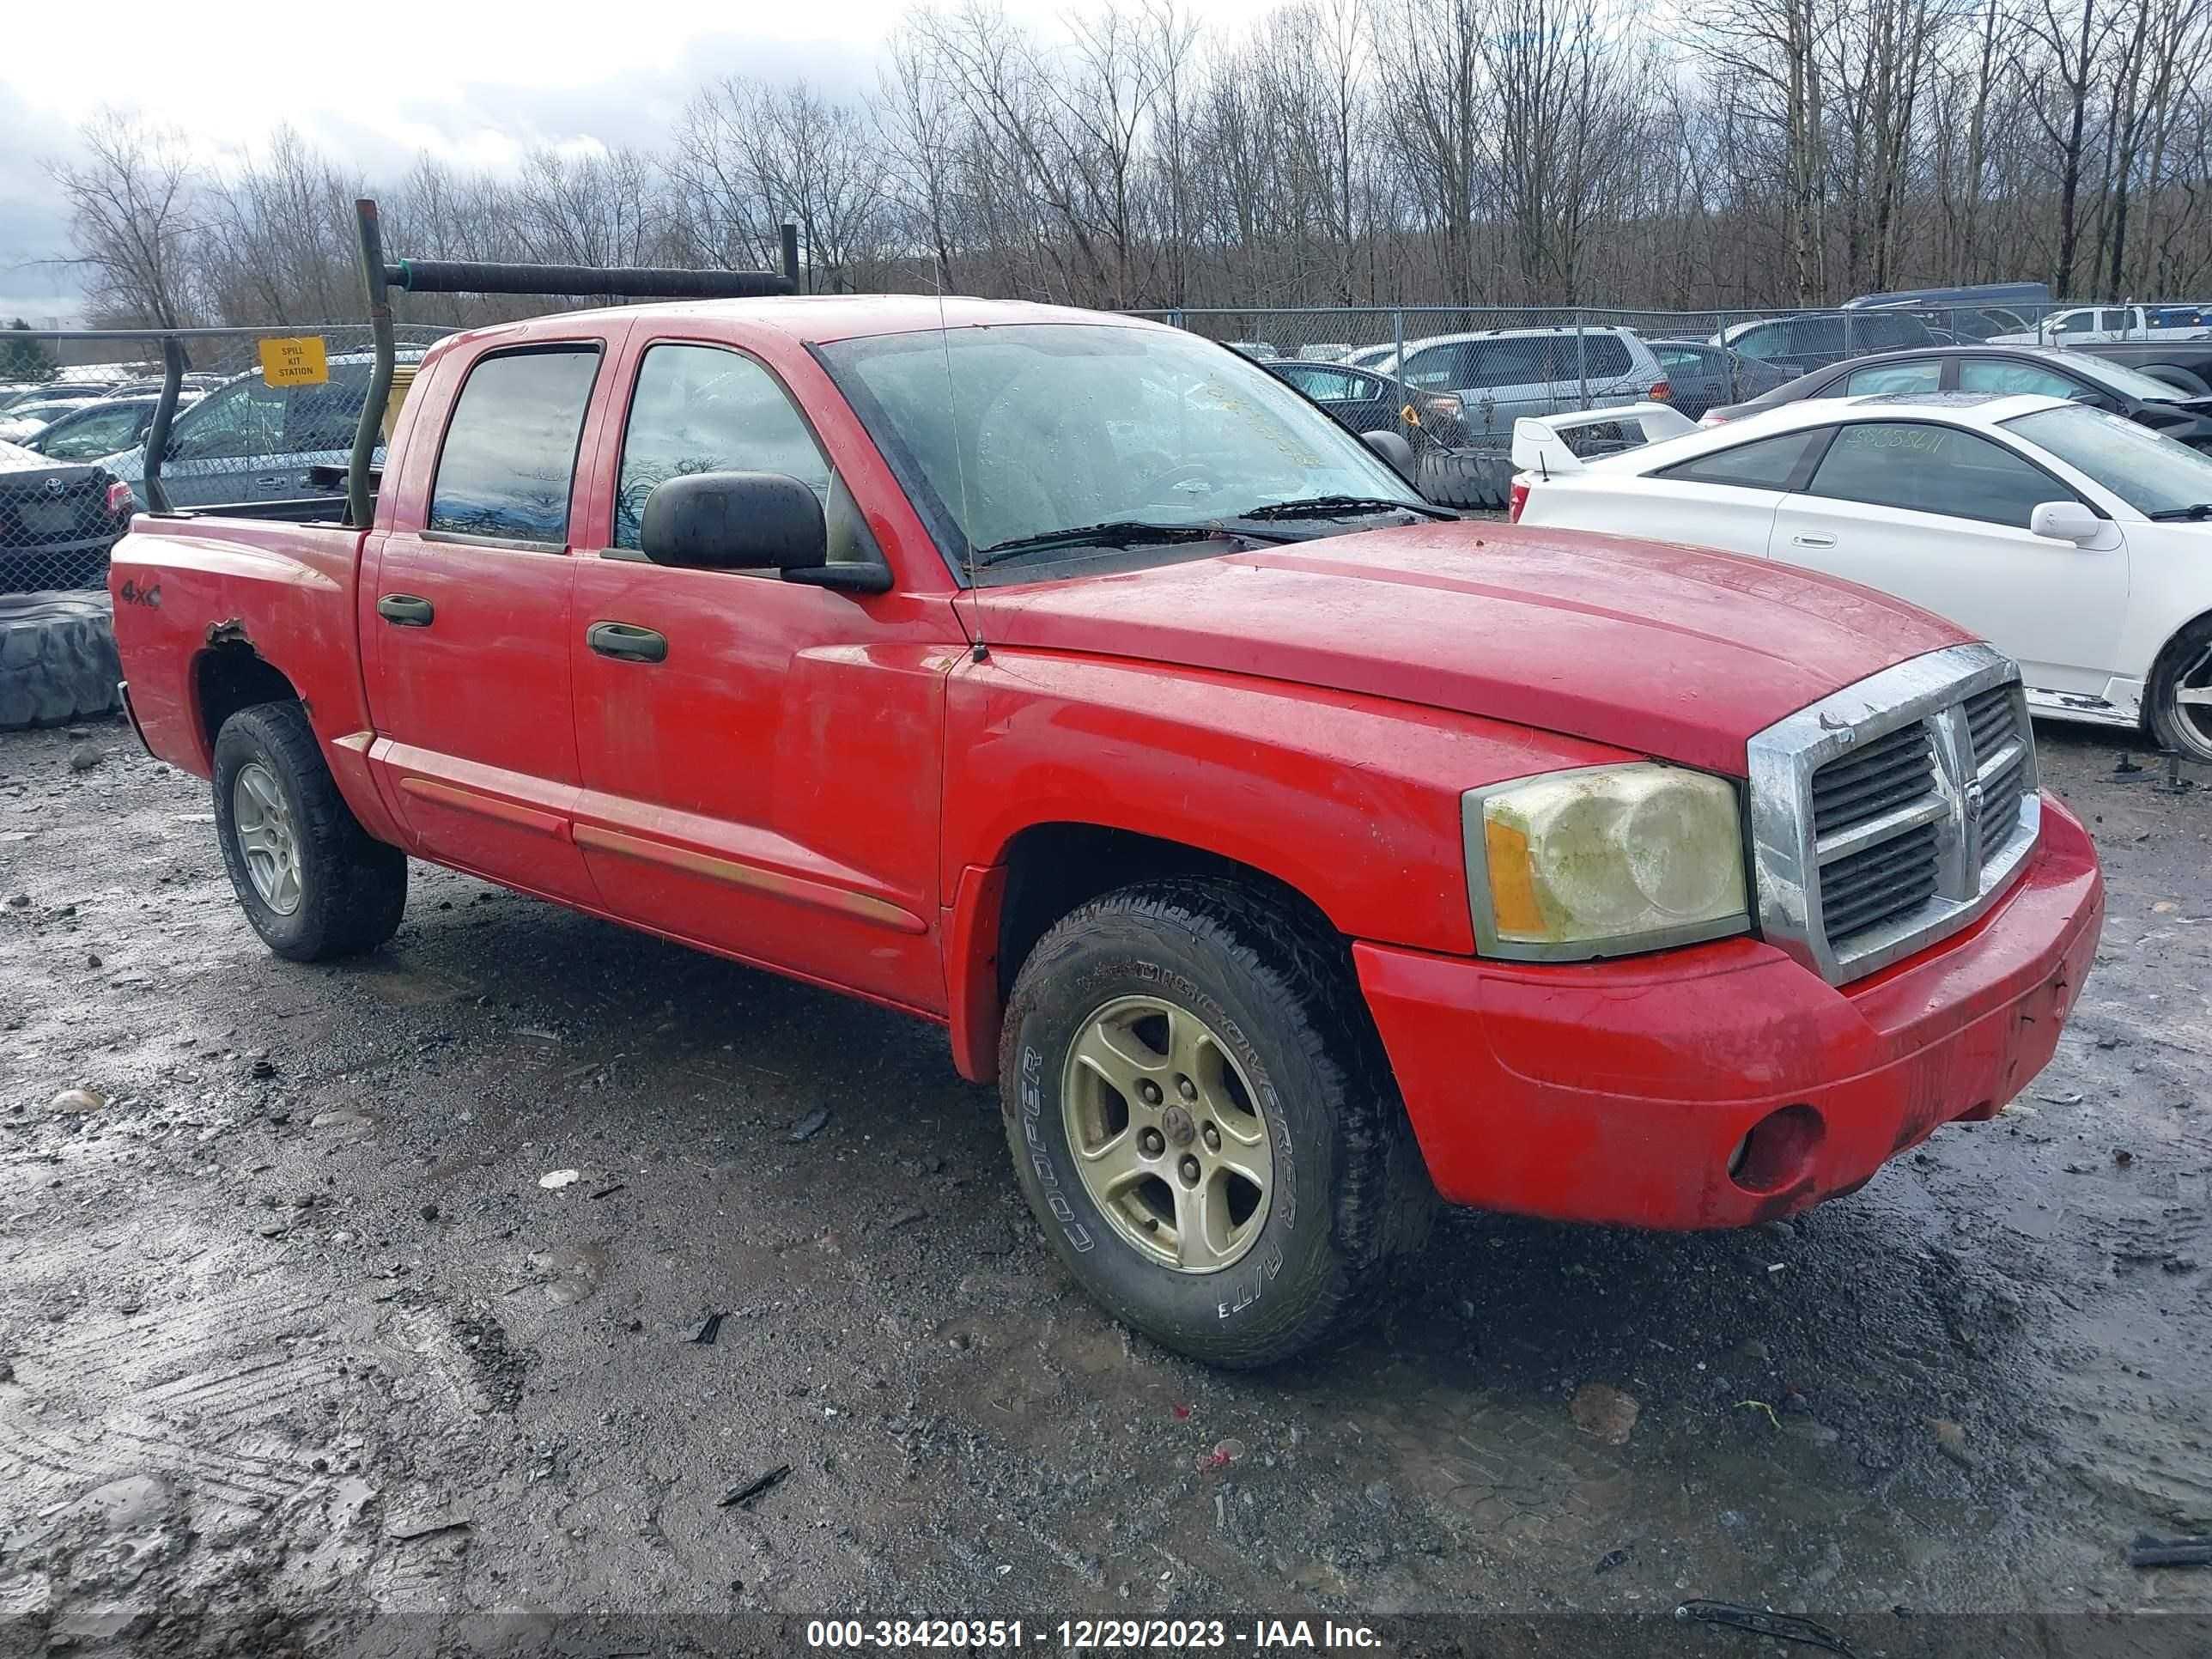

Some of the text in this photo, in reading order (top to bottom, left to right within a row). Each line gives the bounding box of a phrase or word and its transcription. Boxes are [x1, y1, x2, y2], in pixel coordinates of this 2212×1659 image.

[281, 346, 304, 356] SPILL
[288, 356, 301, 366] KIT
[278, 367, 313, 377] STATION
[1022, 1045, 1096, 1253] COOPER
